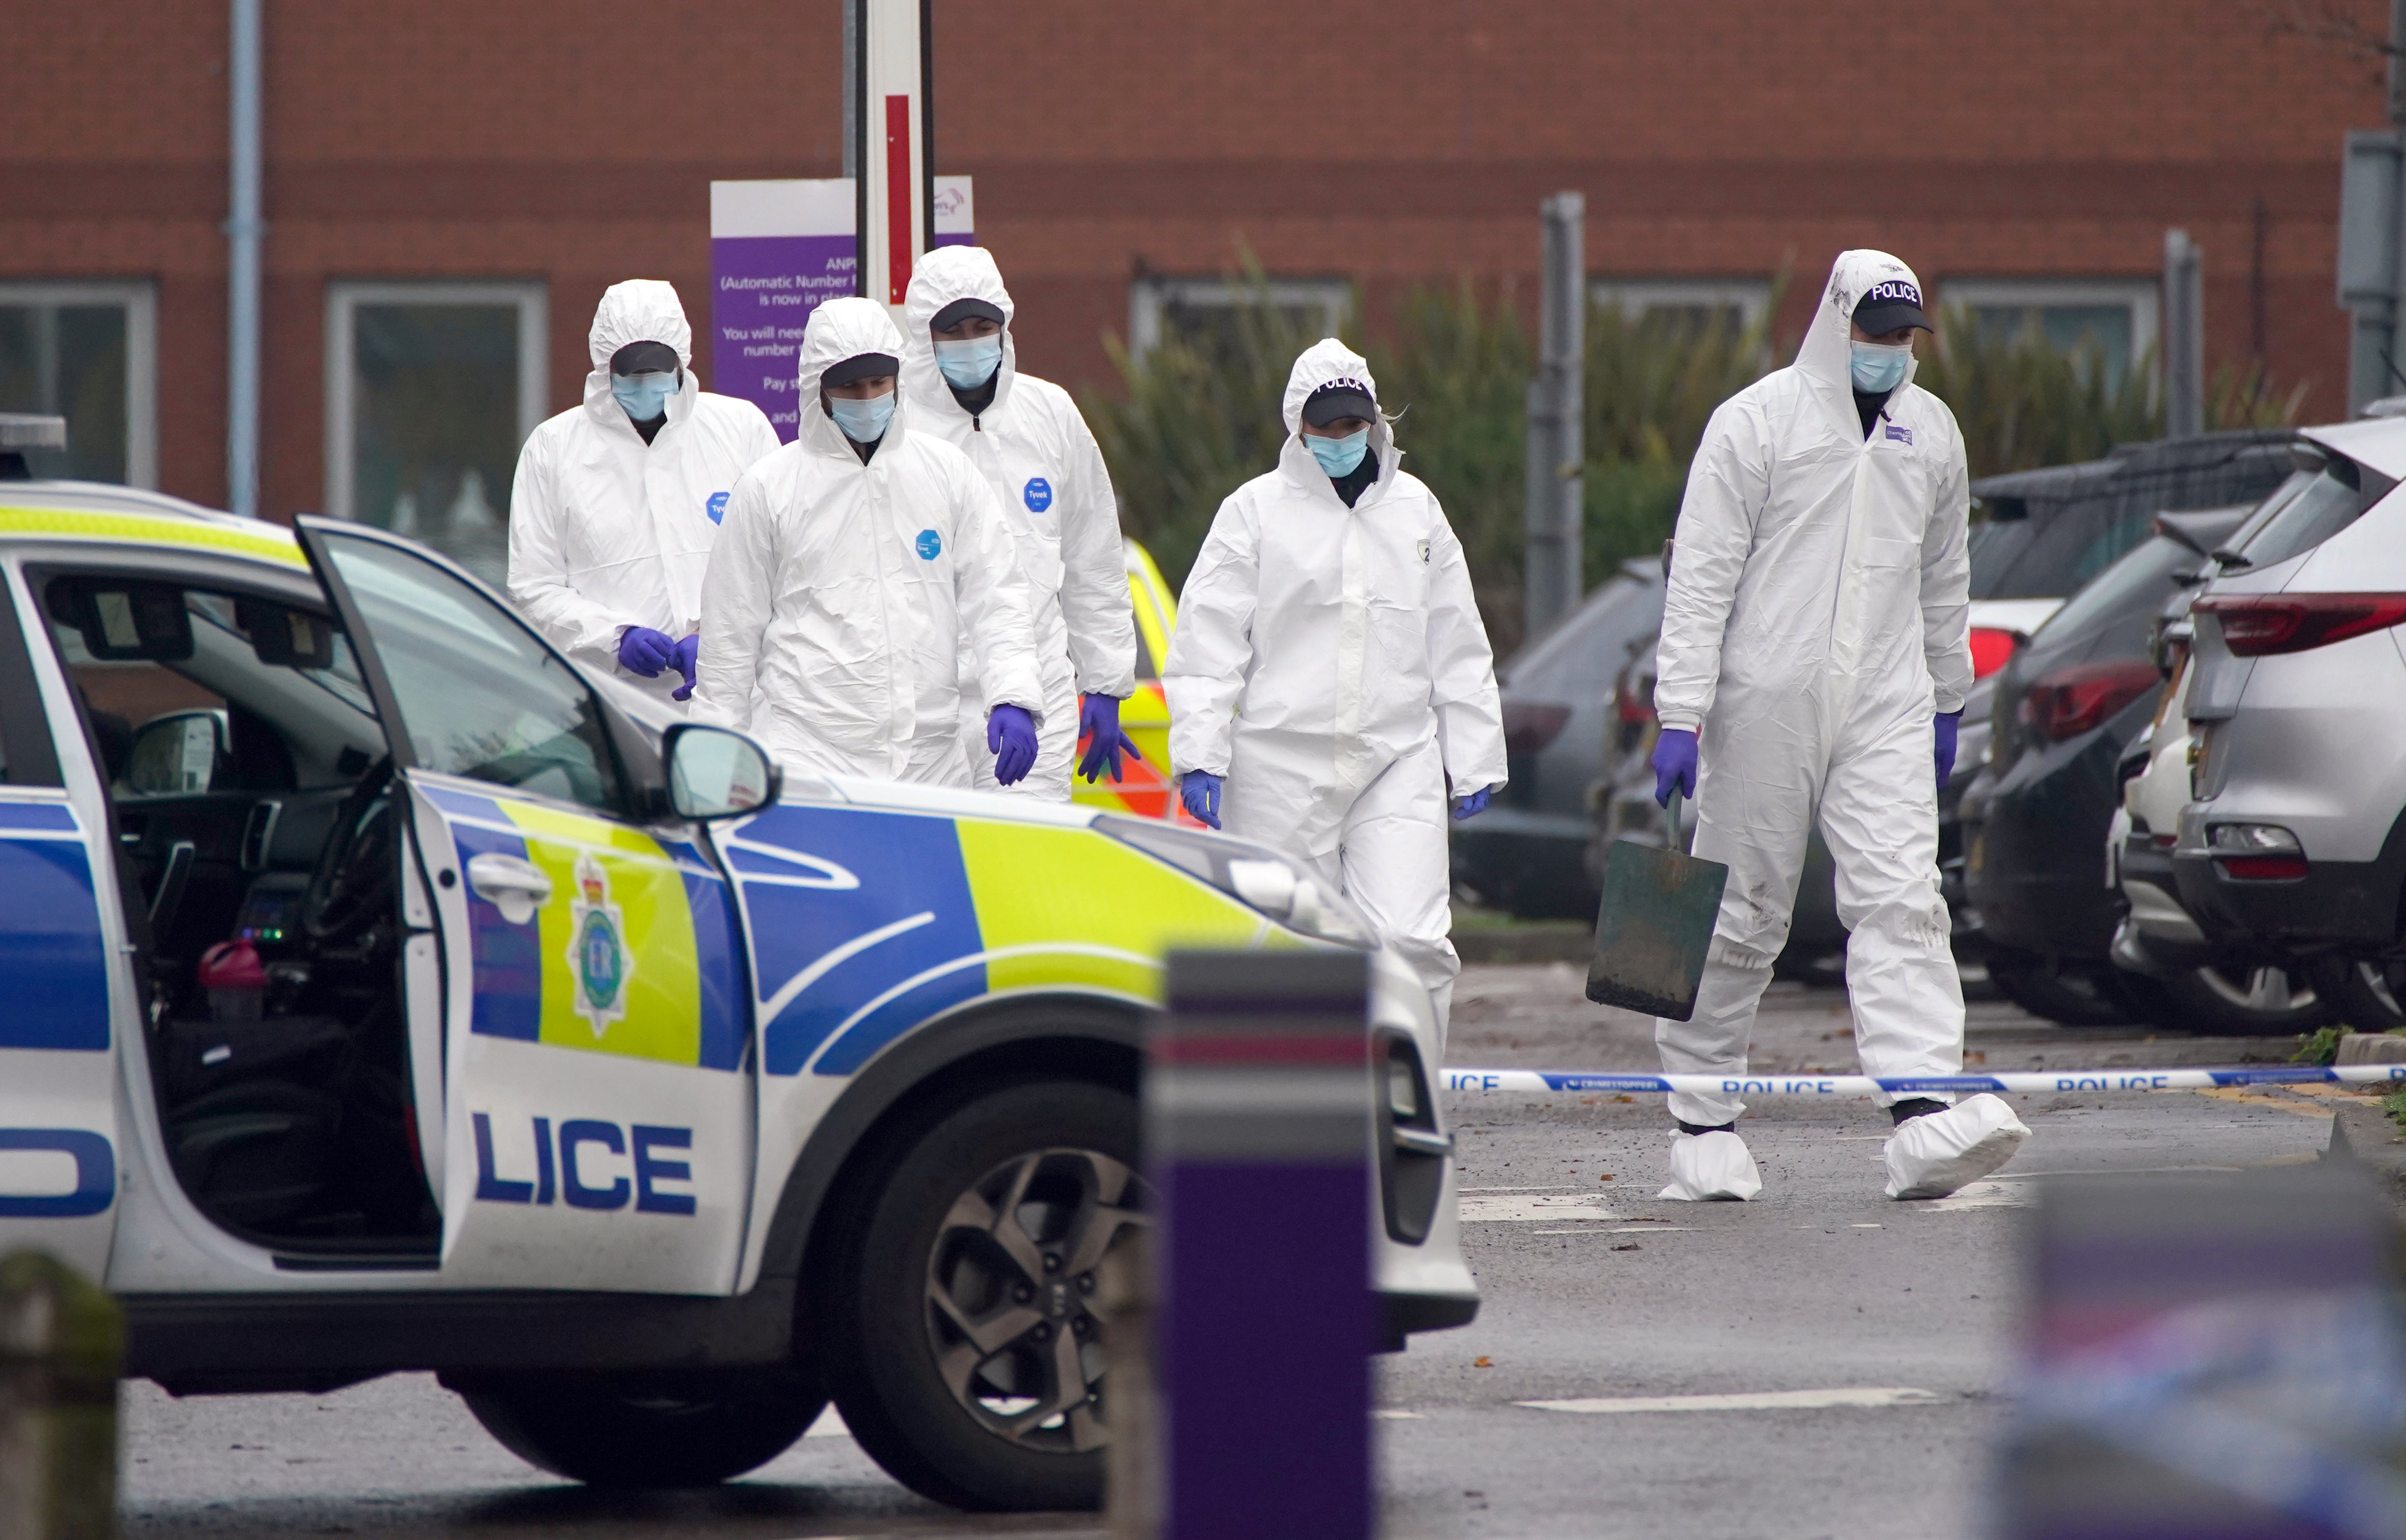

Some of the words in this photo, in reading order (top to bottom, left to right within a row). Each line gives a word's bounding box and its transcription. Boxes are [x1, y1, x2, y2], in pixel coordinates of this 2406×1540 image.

[720, 276, 792, 291] (Automatic
[796, 275, 848, 288] Number
[759, 291, 769, 306] is
[772, 294, 803, 305] now
[805, 291, 818, 305] in
[1872, 283, 1917, 302] POLICE
[722, 327, 748, 340] You
[751, 326, 775, 339] will
[778, 328, 804, 340] nee
[744, 344, 795, 356] number
[763, 377, 787, 393] Pay
[771, 410, 798, 423] and
[1029, 491, 1048, 499] Tyvek
[1425, 548, 1430, 562] 2
[473, 1112, 697, 1217] LICE
